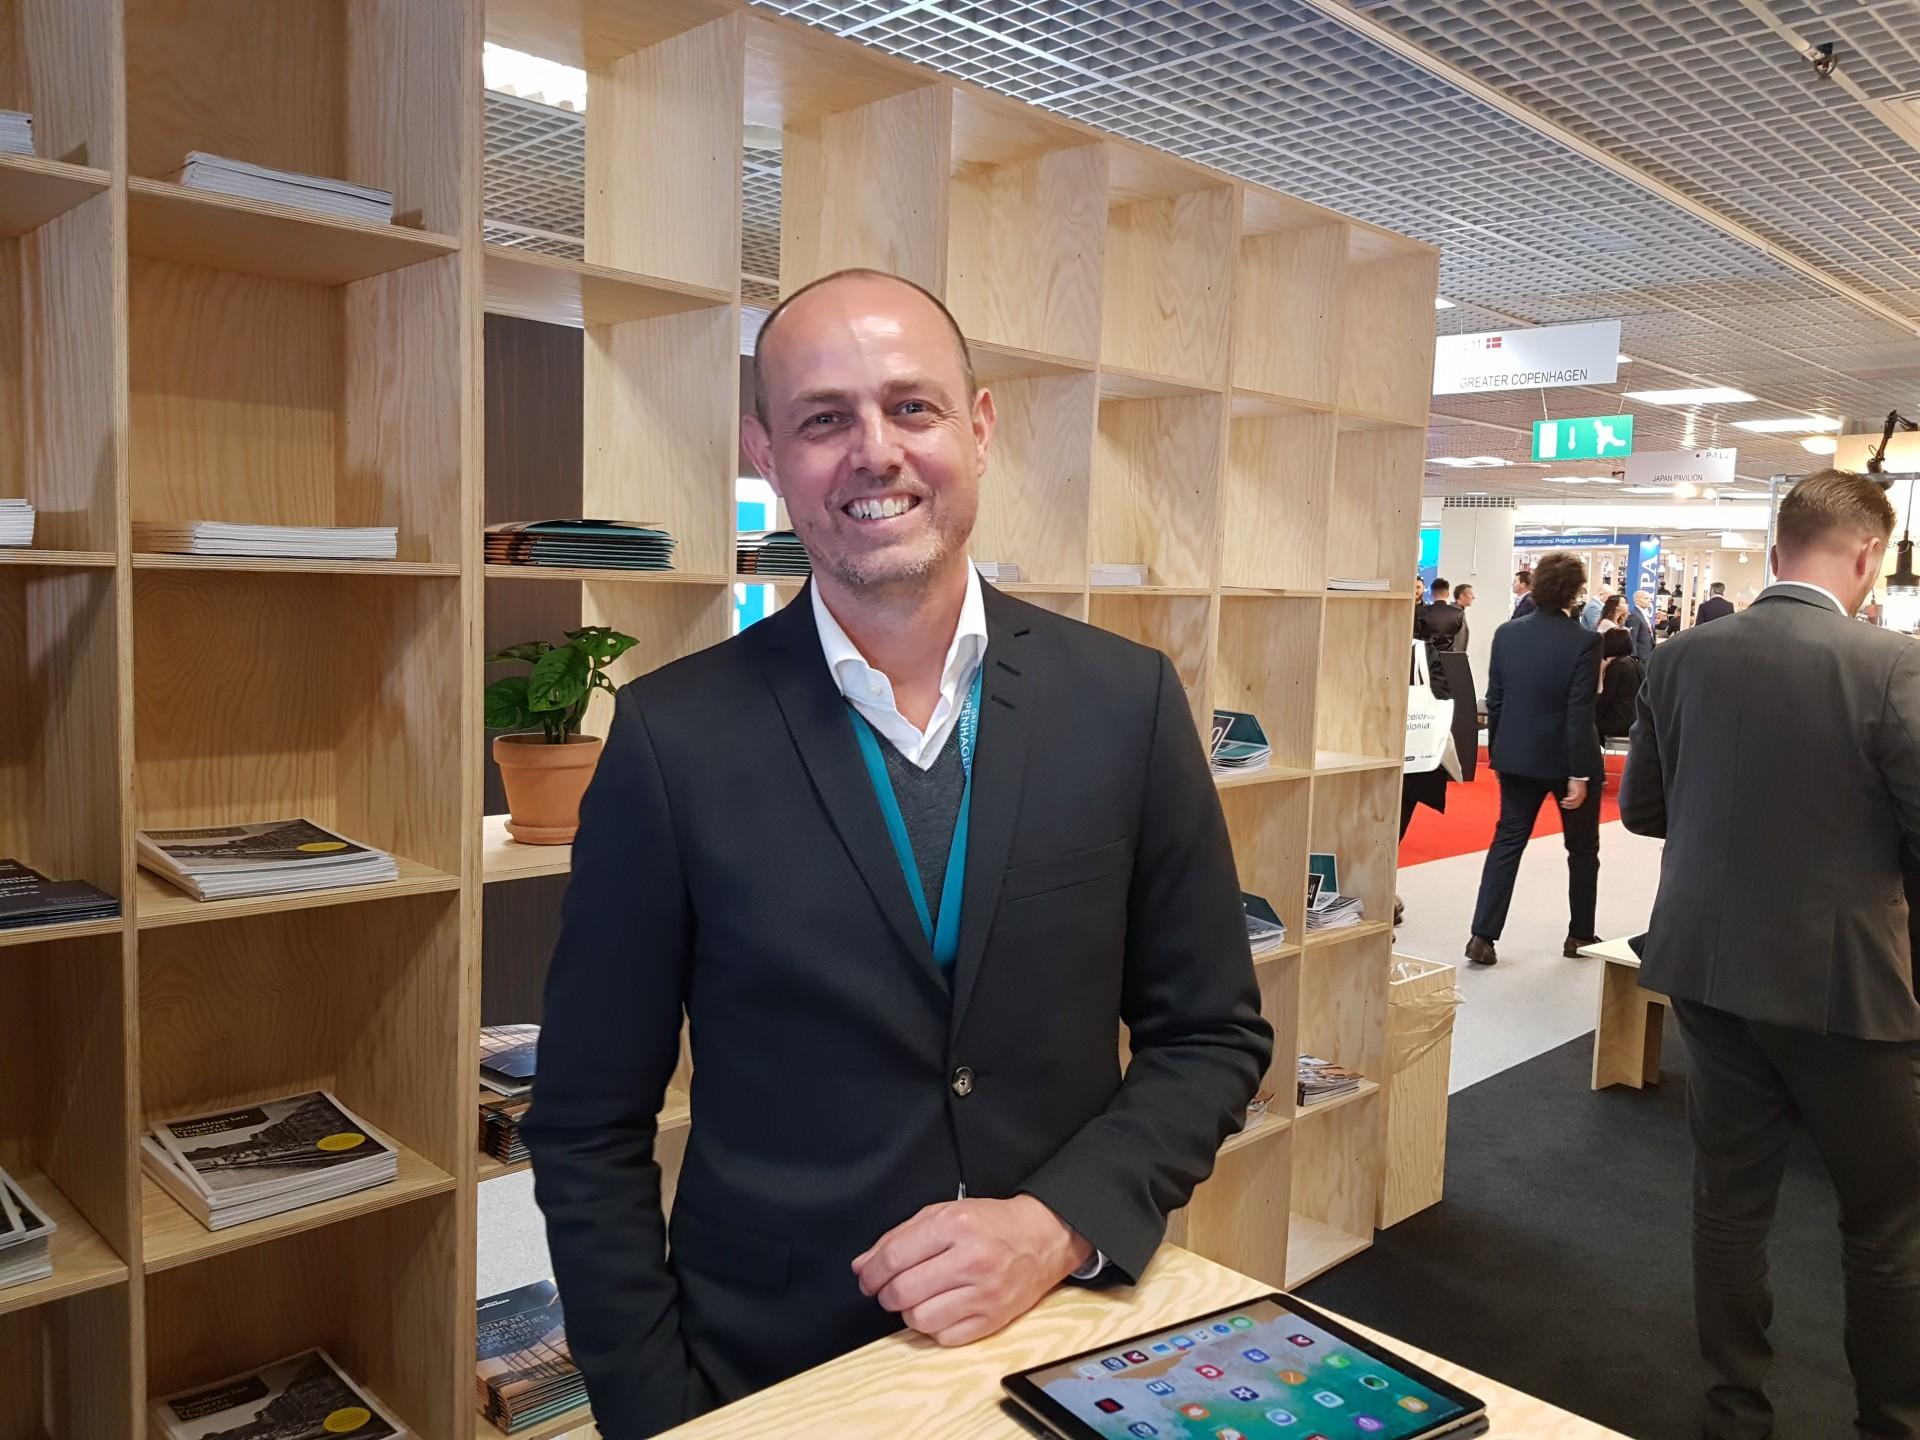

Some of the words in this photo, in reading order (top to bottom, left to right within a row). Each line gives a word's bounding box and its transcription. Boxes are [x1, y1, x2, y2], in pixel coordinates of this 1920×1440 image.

[1459, 373, 1508, 389] GREATER
[1511, 368, 1588, 386] COPENHAGEN
[1653, 474, 1673, 482] JAPAN
[1673, 473, 1703, 481] PAVILION
[1555, 537, 1576, 545] Property
[1577, 536, 1607, 544] Association
[960, 694, 972, 770] OPENHAGE
